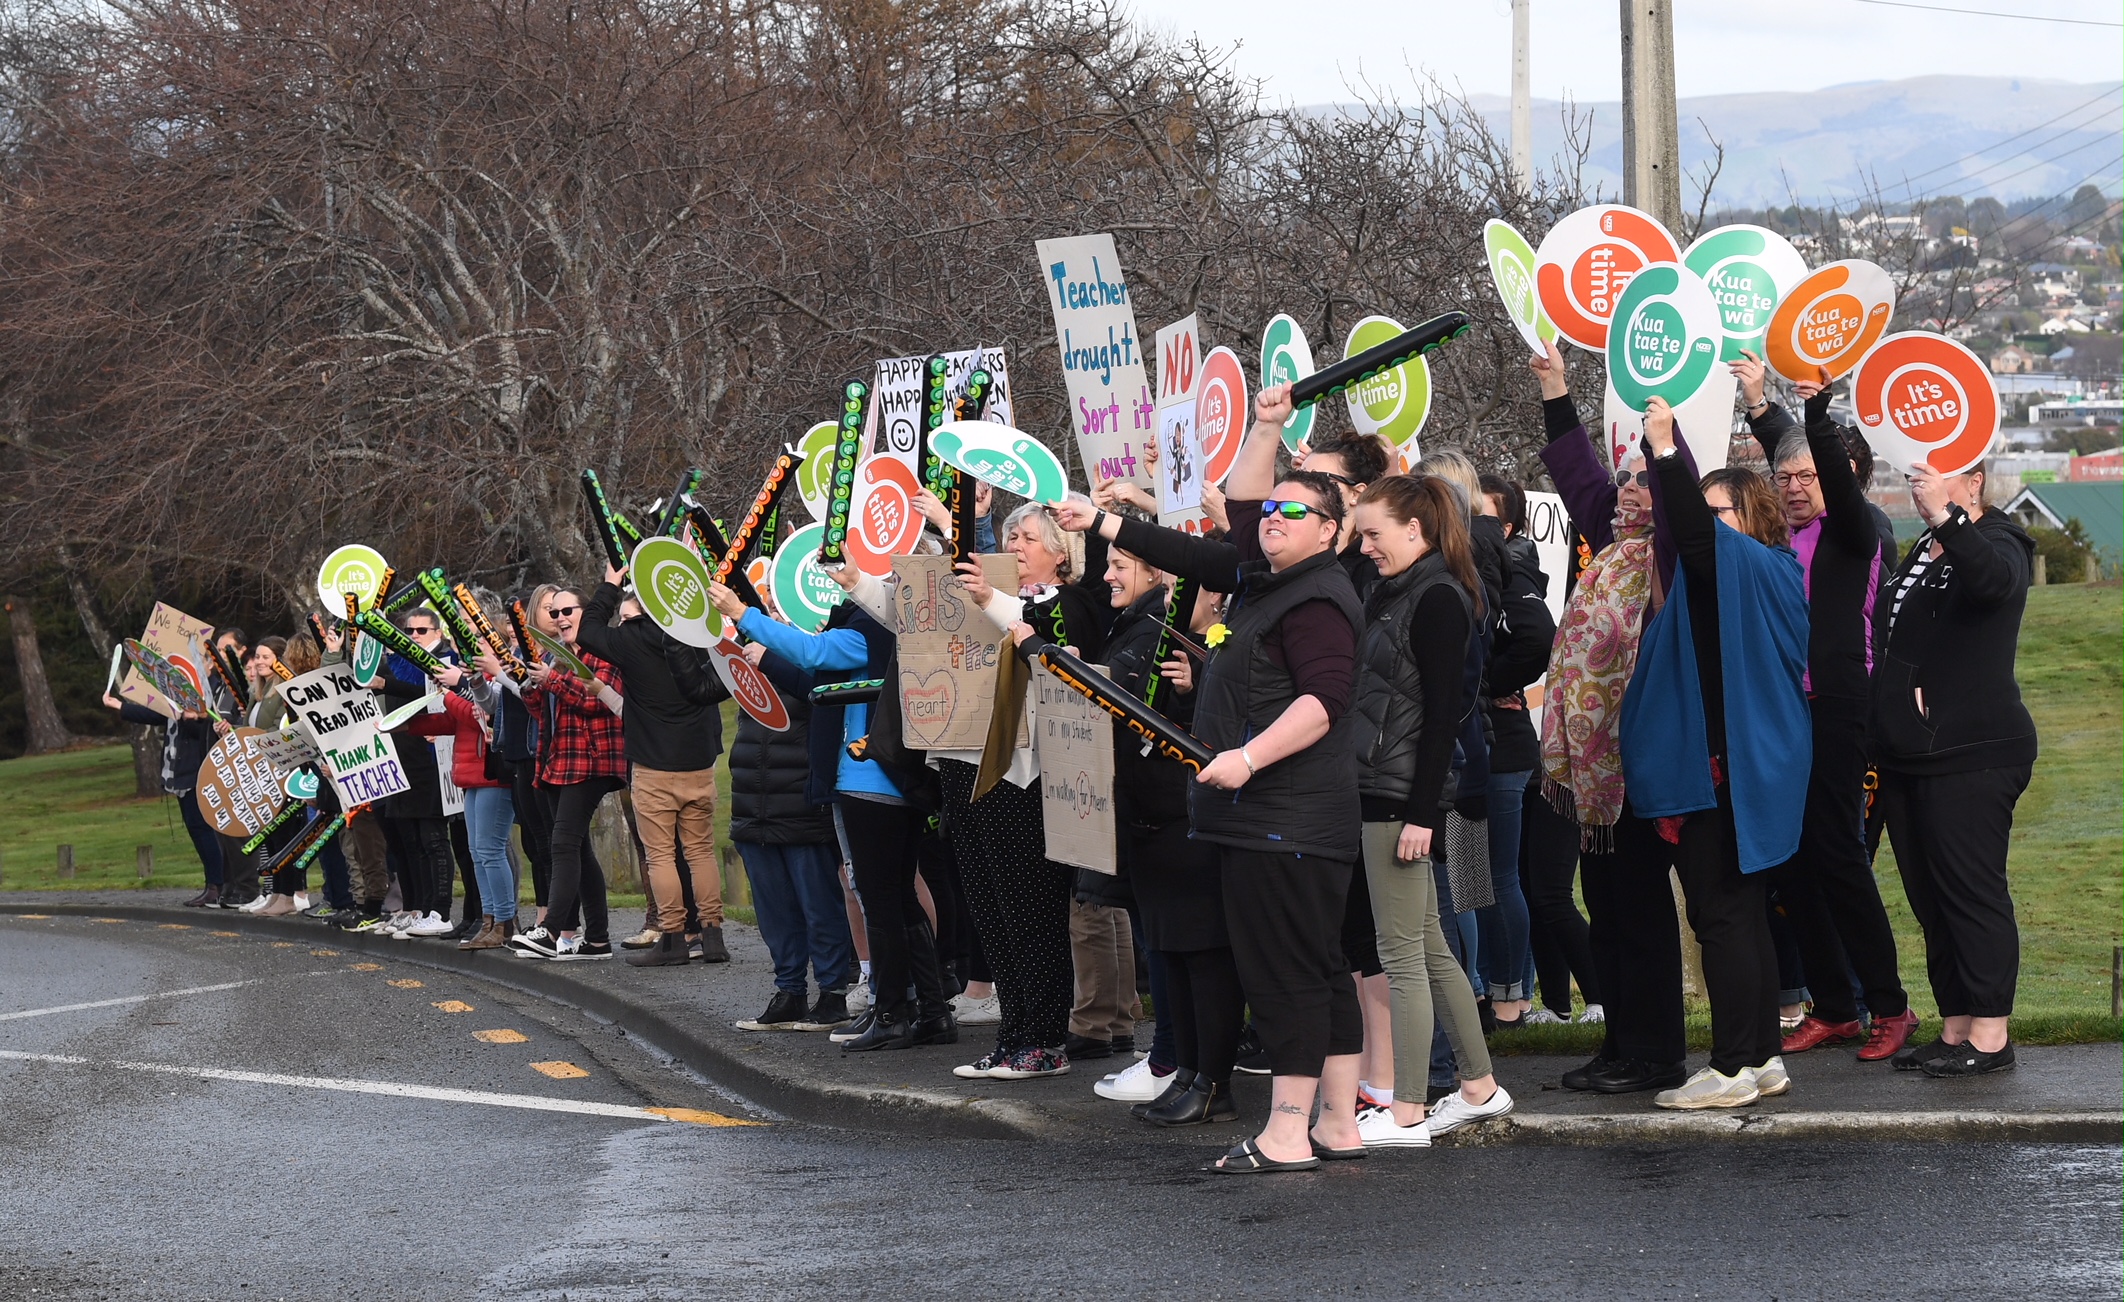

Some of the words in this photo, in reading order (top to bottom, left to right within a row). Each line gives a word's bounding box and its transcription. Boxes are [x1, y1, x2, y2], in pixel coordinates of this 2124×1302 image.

[1050, 256, 1127, 310] Teacher
[1590, 248, 1616, 313] time
[1712, 270, 1752, 291] Kua
[1714, 288, 1747, 307] tae
[1752, 293, 1772, 311] te
[1633, 311, 1664, 334] Kua
[1725, 308, 1755, 326] wā
[1802, 307, 1841, 327] Kua
[1806, 324, 1838, 341] tae
[1841, 315, 1859, 332] te
[1064, 322, 1139, 386] drought.
[1634, 332, 1659, 351] tae
[1662, 335, 1680, 354] te
[1817, 333, 1844, 354] wā
[1162, 331, 1194, 398] NO
[1273, 360, 1288, 379] Kua
[1640, 352, 1664, 371] wā
[882, 389, 921, 414] HAPP
[1362, 382, 1399, 407] time
[1907, 380, 1943, 404] It's
[1079, 392, 1120, 435] Sort
[1132, 386, 1154, 430] it
[1208, 395, 1222, 418] It's
[1894, 400, 1959, 429] time
[1201, 415, 1225, 442] time
[996, 459, 1017, 474] te
[1100, 443, 1137, 480] out
[612, 513, 640, 541] NZEI
[868, 493, 889, 545] time
[884, 500, 900, 530] It's
[338, 580, 369, 593] time
[348, 570, 365, 581] It's
[664, 571, 685, 594] It's
[807, 573, 835, 589] tae
[417, 570, 446, 603] NZEI
[438, 599, 457, 619] TE
[671, 579, 699, 615] time
[816, 589, 840, 605] wā
[154, 610, 171, 629] We
[453, 582, 481, 616] NZEI
[473, 612, 493, 634] TE
[364, 610, 395, 637] NZEI
[390, 631, 409, 648] TE
[947, 634, 997, 671] the
[286, 682, 329, 706] CAN
[323, 672, 365, 696] YOU
[1038, 674, 1051, 704] I'm
[1054, 682, 1065, 703] not
[306, 711, 349, 735] READ
[342, 692, 380, 724] THIS?
[906, 690, 948, 718] heart
[226, 732, 240, 756] I'm
[246, 737, 259, 758] fo
[254, 736, 281, 750] Kids
[284, 739, 309, 754] school
[1061, 721, 1070, 750] my
[211, 748, 224, 766] on
[325, 744, 372, 773] THANK
[373, 733, 388, 758] A
[218, 766, 235, 787] out
[255, 758, 283, 807] walking
[202, 784, 221, 807] not
[1043, 771, 1055, 799] I'm
[1056, 778, 1076, 811] walking
[1080, 779, 1088, 805] for
[216, 808, 231, 830] I'm
[229, 788, 259, 835] walking
[257, 803, 272, 823] my
[241, 832, 266, 856] NZEI
[260, 821, 277, 837] TE
